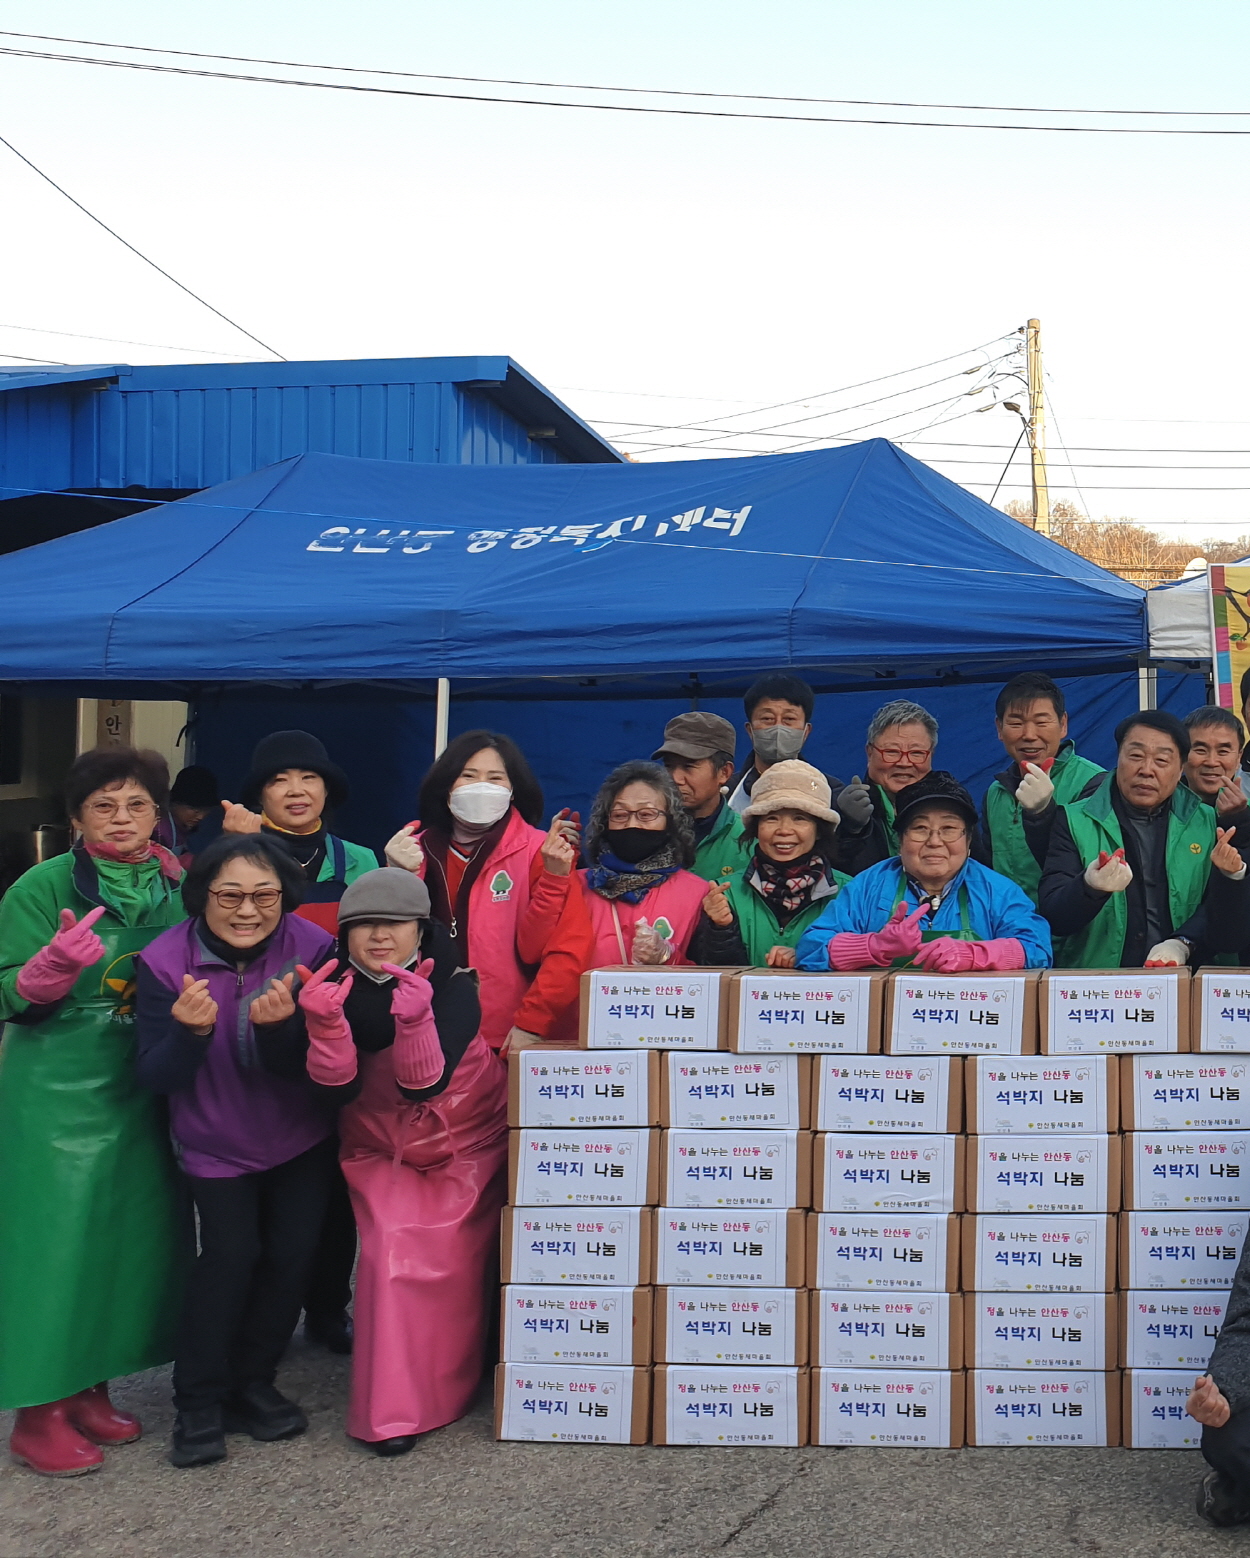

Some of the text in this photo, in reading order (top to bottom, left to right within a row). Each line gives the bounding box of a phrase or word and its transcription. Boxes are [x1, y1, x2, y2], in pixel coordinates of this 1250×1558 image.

[601, 984, 683, 995] 정을 나누는 안산동
[906, 989, 988, 1000] 정을 나누는 안산동
[1214, 989, 1231, 997] 정을
[608, 1005, 695, 1019] 석박지 나눔
[912, 1009, 999, 1025] 석박지 나눔
[1068, 1009, 1154, 1023] 석박지 나눔
[680, 1064, 762, 1076] 정을 나누는 안산동
[988, 1069, 1070, 1081] 정을 나누는 안산동
[689, 1083, 775, 1099] 석박지 나눔
[996, 1090, 1083, 1105] 석박지 나눔
[531, 1142, 612, 1153] 정을 나누는 안산동
[1145, 1142, 1227, 1154] 정을 나누는 안산동
[537, 1161, 624, 1177] 석박지 나눔
[1153, 1164, 1240, 1178] 석박지 나눔
[670, 1222, 750, 1232] 정을 나누는 안산동
[677, 1241, 762, 1256] 석박지 나눔
[517, 1299, 597, 1309] 정을 나누는 안산동
[831, 1303, 913, 1313] 정을 나누는 안산동
[524, 1318, 609, 1333] 석박지 나눔
[839, 1322, 925, 1337] 석박지 나눔
[678, 1384, 761, 1393] 정을 나누는 안산동
[986, 1382, 1069, 1394] 정을 나누는 안산동
[686, 1403, 773, 1417] 석박지 나눔
[995, 1403, 1082, 1418] 석박지 나눔
